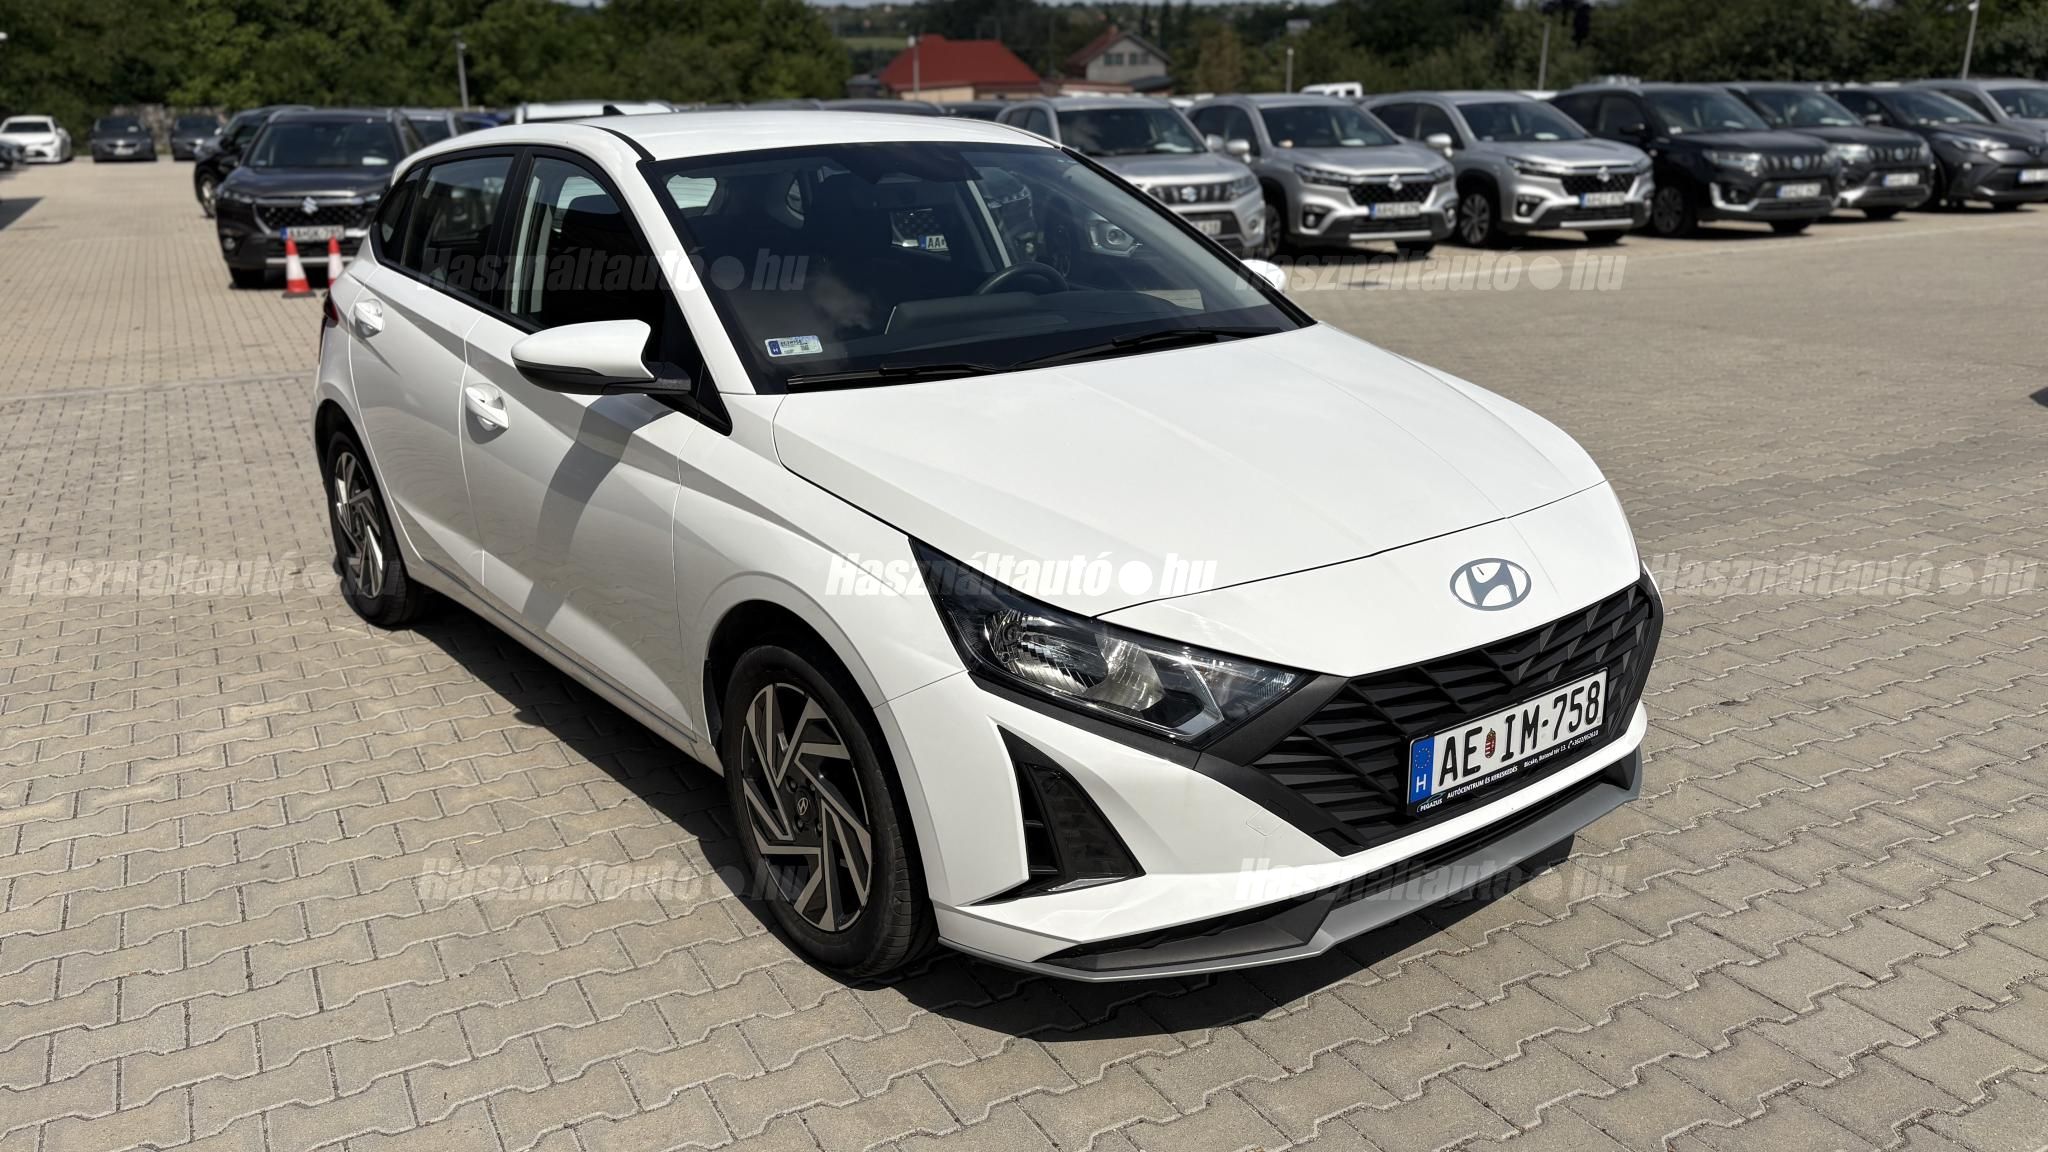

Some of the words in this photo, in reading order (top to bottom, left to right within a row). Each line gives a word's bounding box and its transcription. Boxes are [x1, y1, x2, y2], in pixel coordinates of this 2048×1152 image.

[1438, 726, 1483, 787] AE
[1501, 680, 1601, 763] IM-758
[1415, 773, 1427, 793] H
[1419, 798, 1443, 812] PEGAZUS
